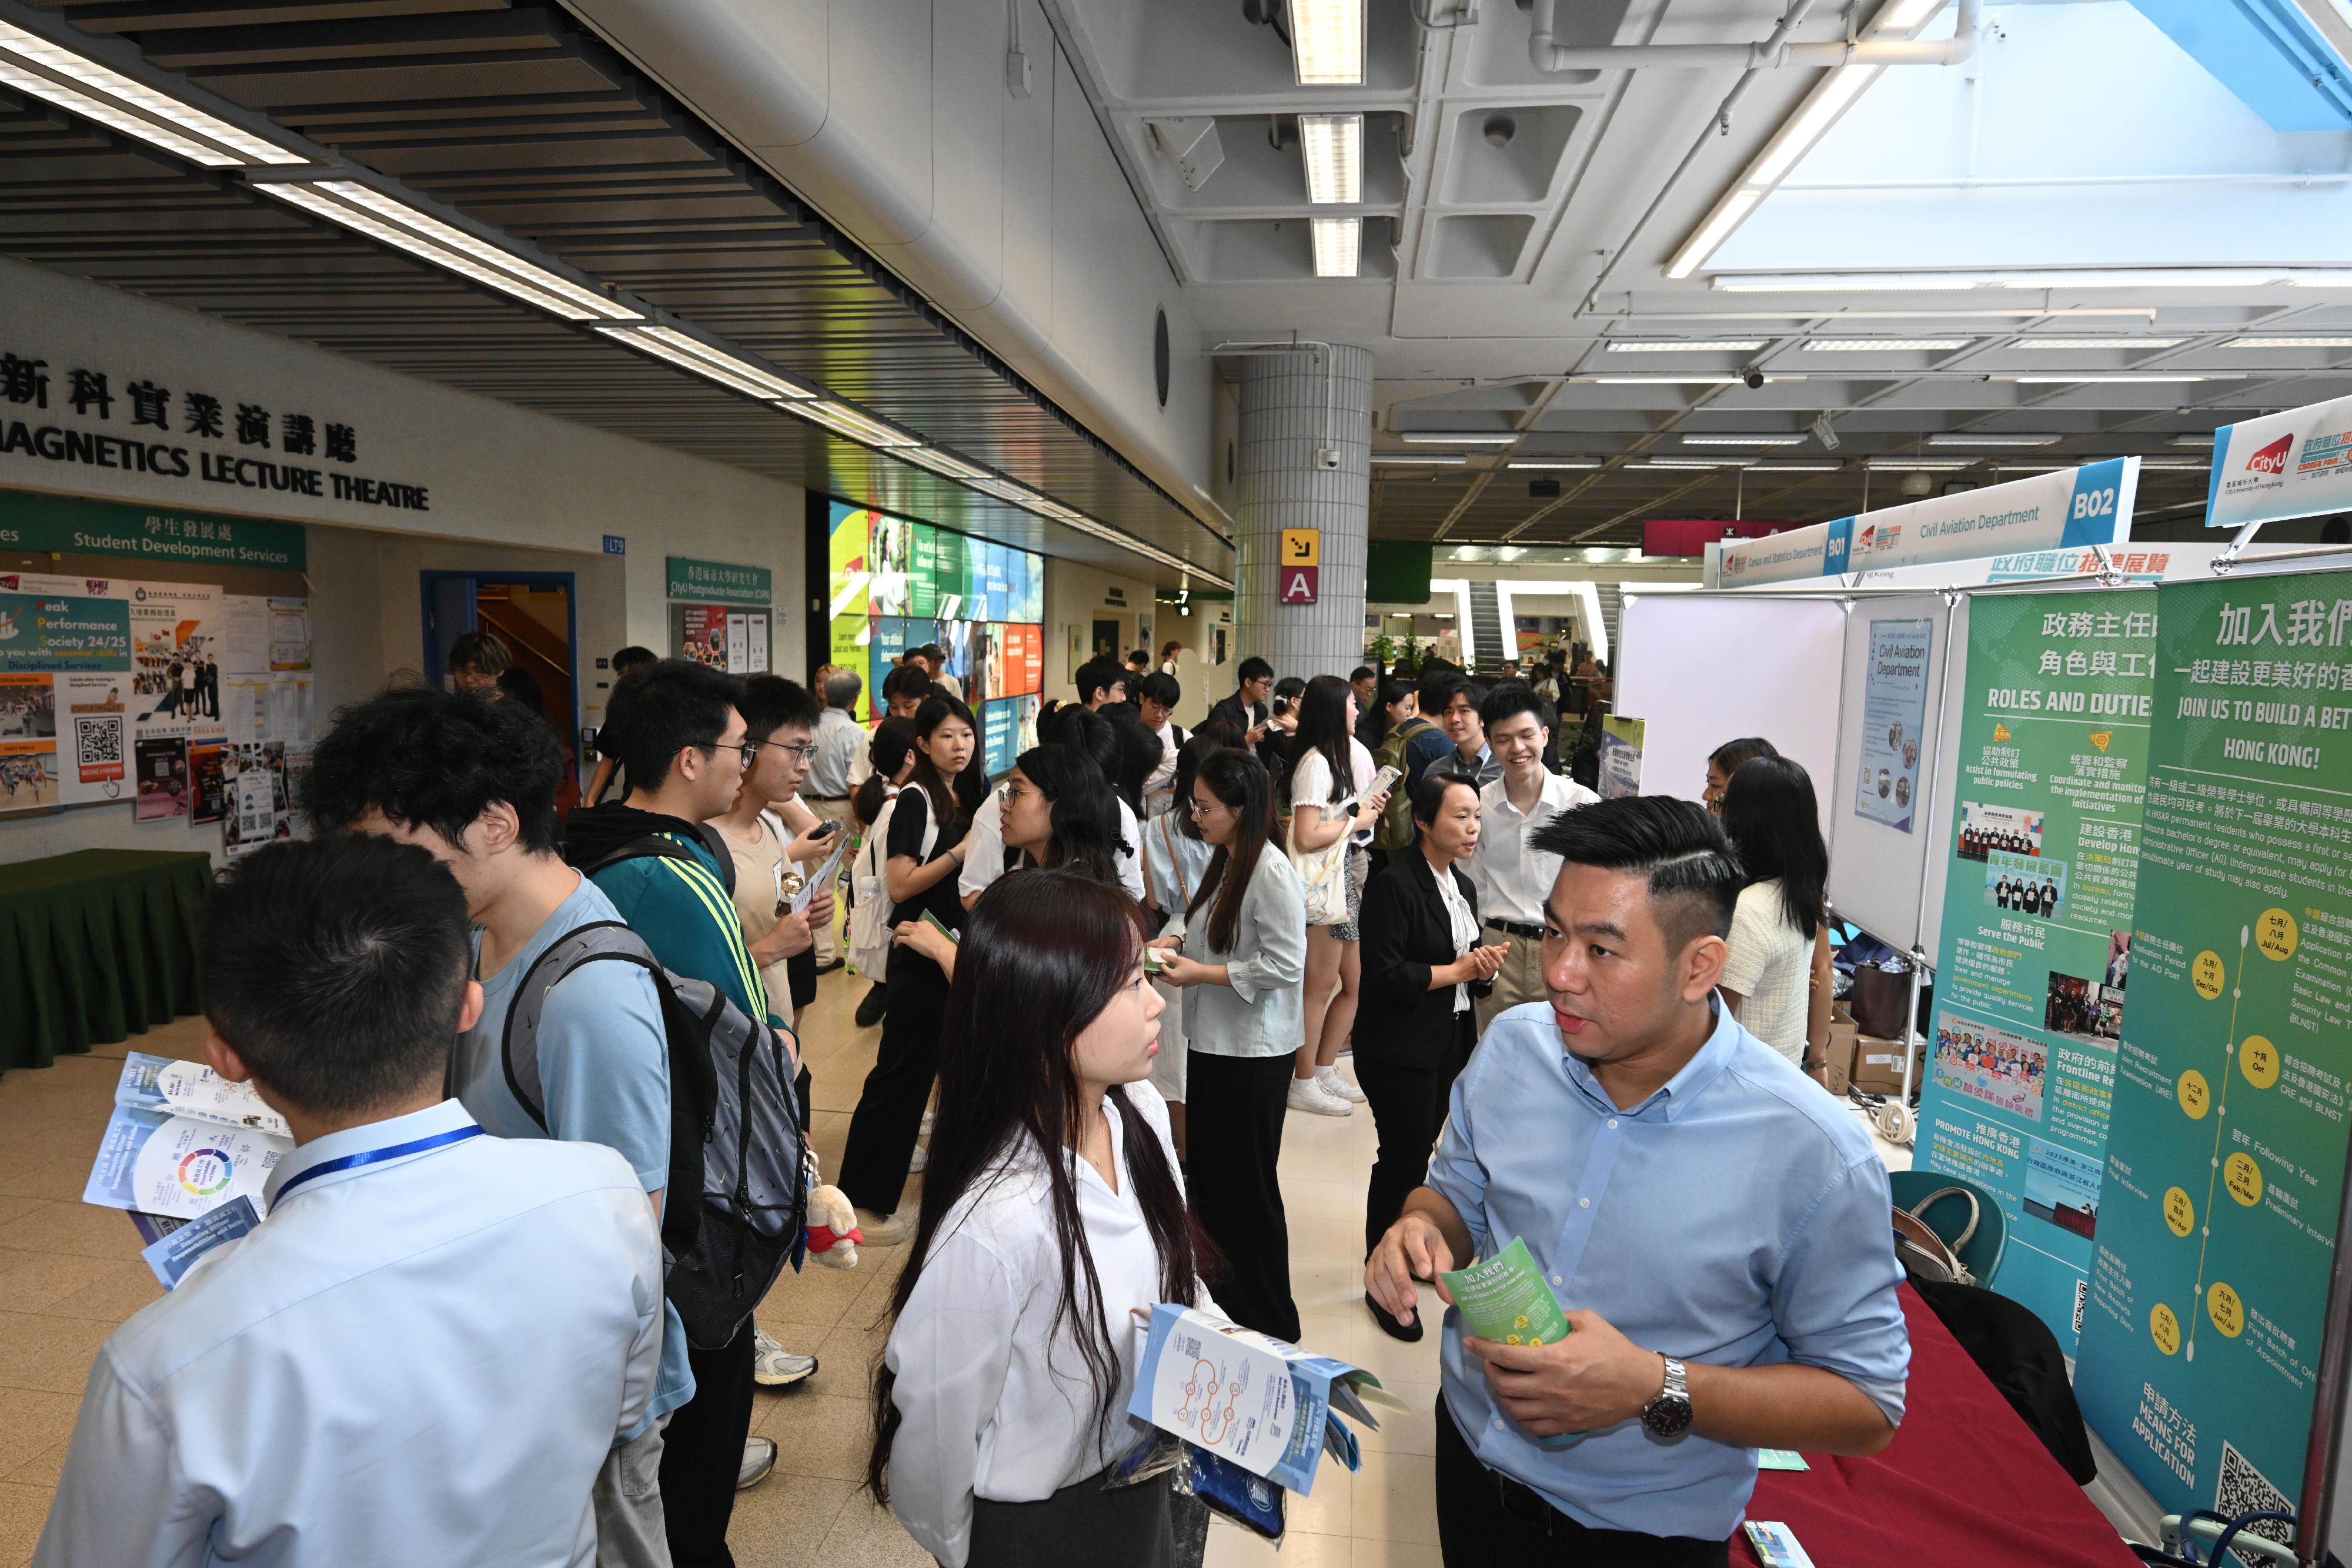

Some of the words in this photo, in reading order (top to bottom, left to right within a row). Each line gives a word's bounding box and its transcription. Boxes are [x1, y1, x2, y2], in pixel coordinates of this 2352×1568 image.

[0, 420, 190, 477] AGNETICS
[201, 452, 323, 497] LECTURE
[330, 473, 429, 511] THEATRE
[2251, 452, 2286, 473] CityU
[2073, 488, 2114, 519] B02
[1920, 523, 1938, 539] Civil
[1940, 517, 1976, 536] Aviation
[1978, 506, 2039, 530] Department
[75, 532, 138, 550] Student
[142, 537, 235, 559] Development
[239, 547, 288, 563] Services
[609, 539, 624, 553] LT9
[1829, 537, 1845, 556] B01
[1749, 556, 1763, 568] Census
[1763, 554, 1772, 564] and
[1772, 551, 1792, 563] Statistics
[1793, 546, 1822, 560] Department
[671, 581, 687, 594] CityU
[689, 583, 724, 597] Postgraduate
[726, 587, 754, 597] Association
[1288, 573, 1311, 597] A
[36, 600, 69, 612] Peak
[38, 617, 118, 631] Performance
[2042, 611, 2158, 638] 政務主任
[28, 648, 52, 657] with
[40, 635, 84, 650] Society
[88, 637, 126, 649] 24/25
[1879, 644, 1893, 657] Civil
[1894, 644, 1925, 658] Aviation
[9, 661, 62, 671] Disciplined
[1877, 661, 1920, 678] Department
[1988, 688, 2041, 710] ROLES
[2046, 691, 2085, 713] AND
[2090, 693, 2153, 717] DUTIE
[2177, 697, 2207, 720] JOIN
[2210, 698, 2230, 720] US
[2234, 700, 2251, 721] TO
[2255, 702, 2300, 726] BUILD
[2303, 706, 2316, 727] A
[2224, 738, 2264, 763] HONG
[2267, 743, 2320, 770] KONG!
[1973, 777, 1994, 788] public
[1996, 778, 2023, 790] policies
[1993, 767, 2037, 782] formulating
[2050, 775, 2092, 788] Coordinate
[2064, 787, 2132, 803] implementation
[2072, 798, 2116, 813] initiatives
[2080, 823, 2133, 841] 建設香港
[2171, 814, 2211, 830] permanent
[2213, 824, 2247, 838] residents
[2249, 831, 2264, 842] who
[2267, 836, 2302, 851] possess
[2313, 843, 2329, 857] first
[2078, 837, 2117, 852] Develop
[2186, 847, 2209, 860] Officer
[2230, 857, 2286, 880] Undergraduate
[2288, 872, 2325, 890] students
[2287, 856, 2307, 870] may
[2310, 861, 2332, 877] apply
[2071, 903, 2098, 914] society
[2072, 893, 2099, 904] closely
[2102, 898, 2128, 909] related
[2000, 918, 2045, 939] 服務市民
[2070, 912, 2109, 926] resources.
[1978, 926, 2002, 940] Serve
[2019, 936, 2045, 950] Public
[2261, 940, 2288, 955] Jul/Aug
[2300, 938, 2342, 959] Application
[2165, 954, 2186, 969] Period
[2314, 958, 2346, 978] Common
[1953, 975, 1989, 989] government
[1991, 982, 2033, 1002] departments
[1984, 973, 2011, 986] manage
[2296, 968, 2341, 992] Examination
[1959, 985, 1982, 998] provide
[1984, 992, 2006, 1006] quality
[2008, 1000, 2034, 1012] services
[2293, 982, 2313, 998] Basic
[2316, 991, 2331, 1005] Law
[2291, 998, 2321, 1018] Security
[2324, 1012, 2341, 1025] Law
[2290, 1012, 2319, 1034] (BLNST)
[2057, 1061, 2100, 1082] Frontline
[2120, 1065, 2153, 1090] Examination
[2134, 1061, 2172, 1086] Recruitment
[2062, 1099, 2087, 1112] district
[2315, 1101, 2343, 1123] BLNST
[2067, 1112, 2100, 1127] provision
[2067, 1122, 2096, 1136] oversee
[1935, 1118, 1971, 1140] PROMOTE
[1973, 1134, 1994, 1150] HONG
[1997, 1144, 2019, 1159] KONG
[1976, 1122, 2020, 1149] 推廣香港
[2050, 1125, 2098, 1147] programmes.
[1930, 1159, 1941, 1170] May
[2254, 1141, 2294, 1174] Following
[2299, 1166, 2318, 1187] Year
[2122, 1174, 2149, 1200] Interview
[2265, 1198, 2303, 1229] Preliminary
[2266, 1336, 2287, 1359] Batch
[2256, 1345, 2303, 1389] Appointment
[2143, 1382, 2196, 1446] 申請方法
[2140, 1400, 2172, 1445] MEANS
[2174, 1436, 2194, 1467] FOR
[2132, 1416, 2195, 1490] APPLICATION
